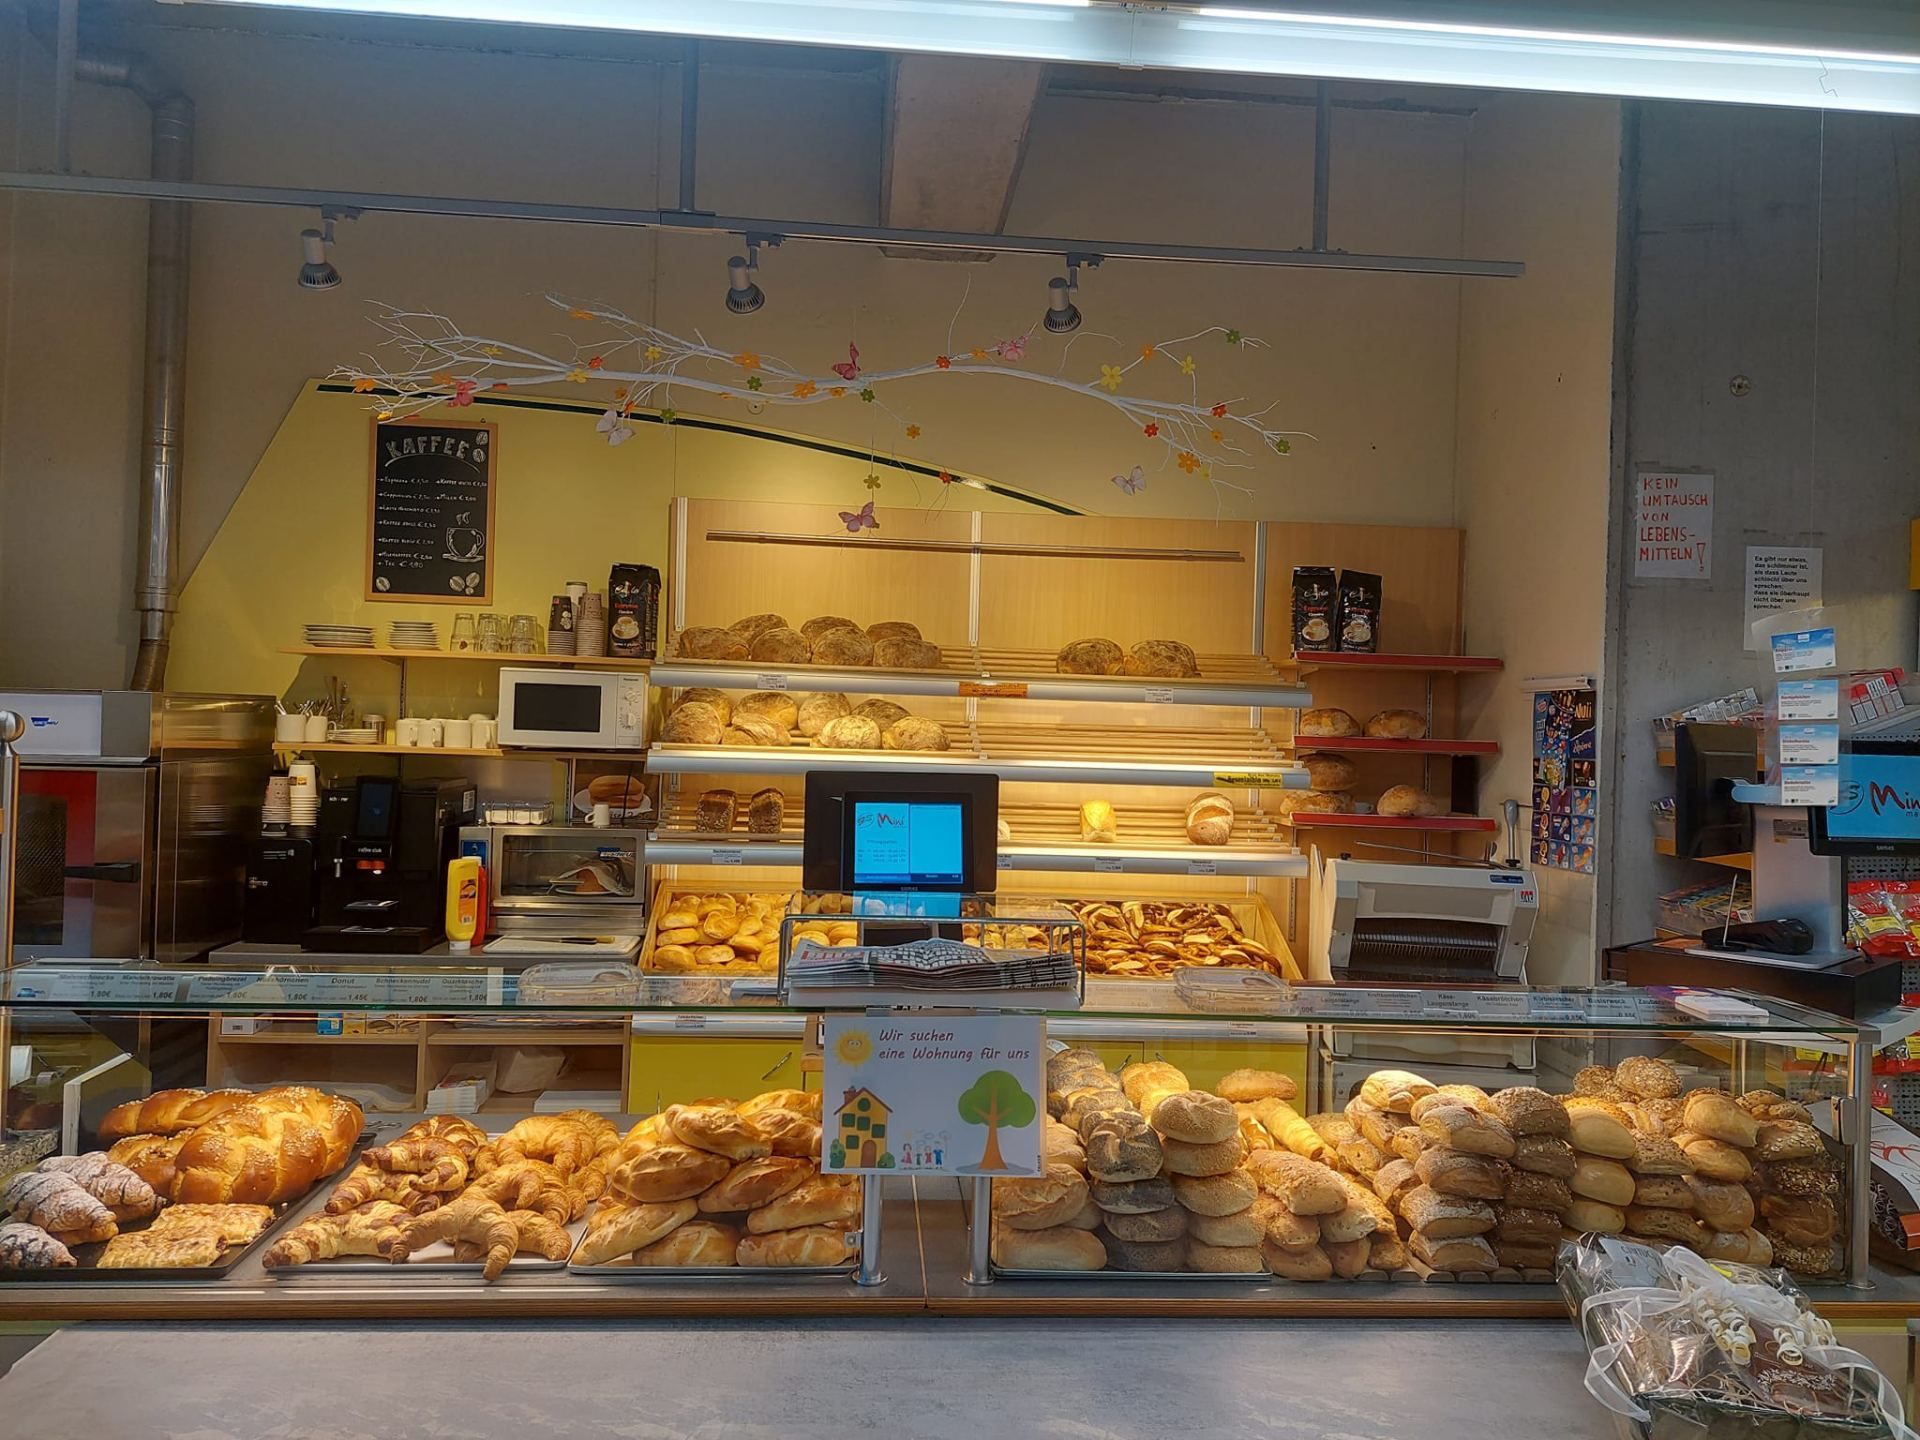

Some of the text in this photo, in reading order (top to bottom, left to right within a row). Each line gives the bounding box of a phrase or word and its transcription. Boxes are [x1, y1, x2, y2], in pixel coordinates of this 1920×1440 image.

[386, 436, 469, 458] KAFFEE
[1643, 478, 1678, 490] KEIN
[1642, 494, 1708, 506] UMTAUSCH
[1642, 512, 1669, 522] VON
[1640, 527, 1695, 542] LEBENS-
[879, 1029, 954, 1042] Wir suchen
[879, 1048, 1030, 1062] eine Wohnung für uns
